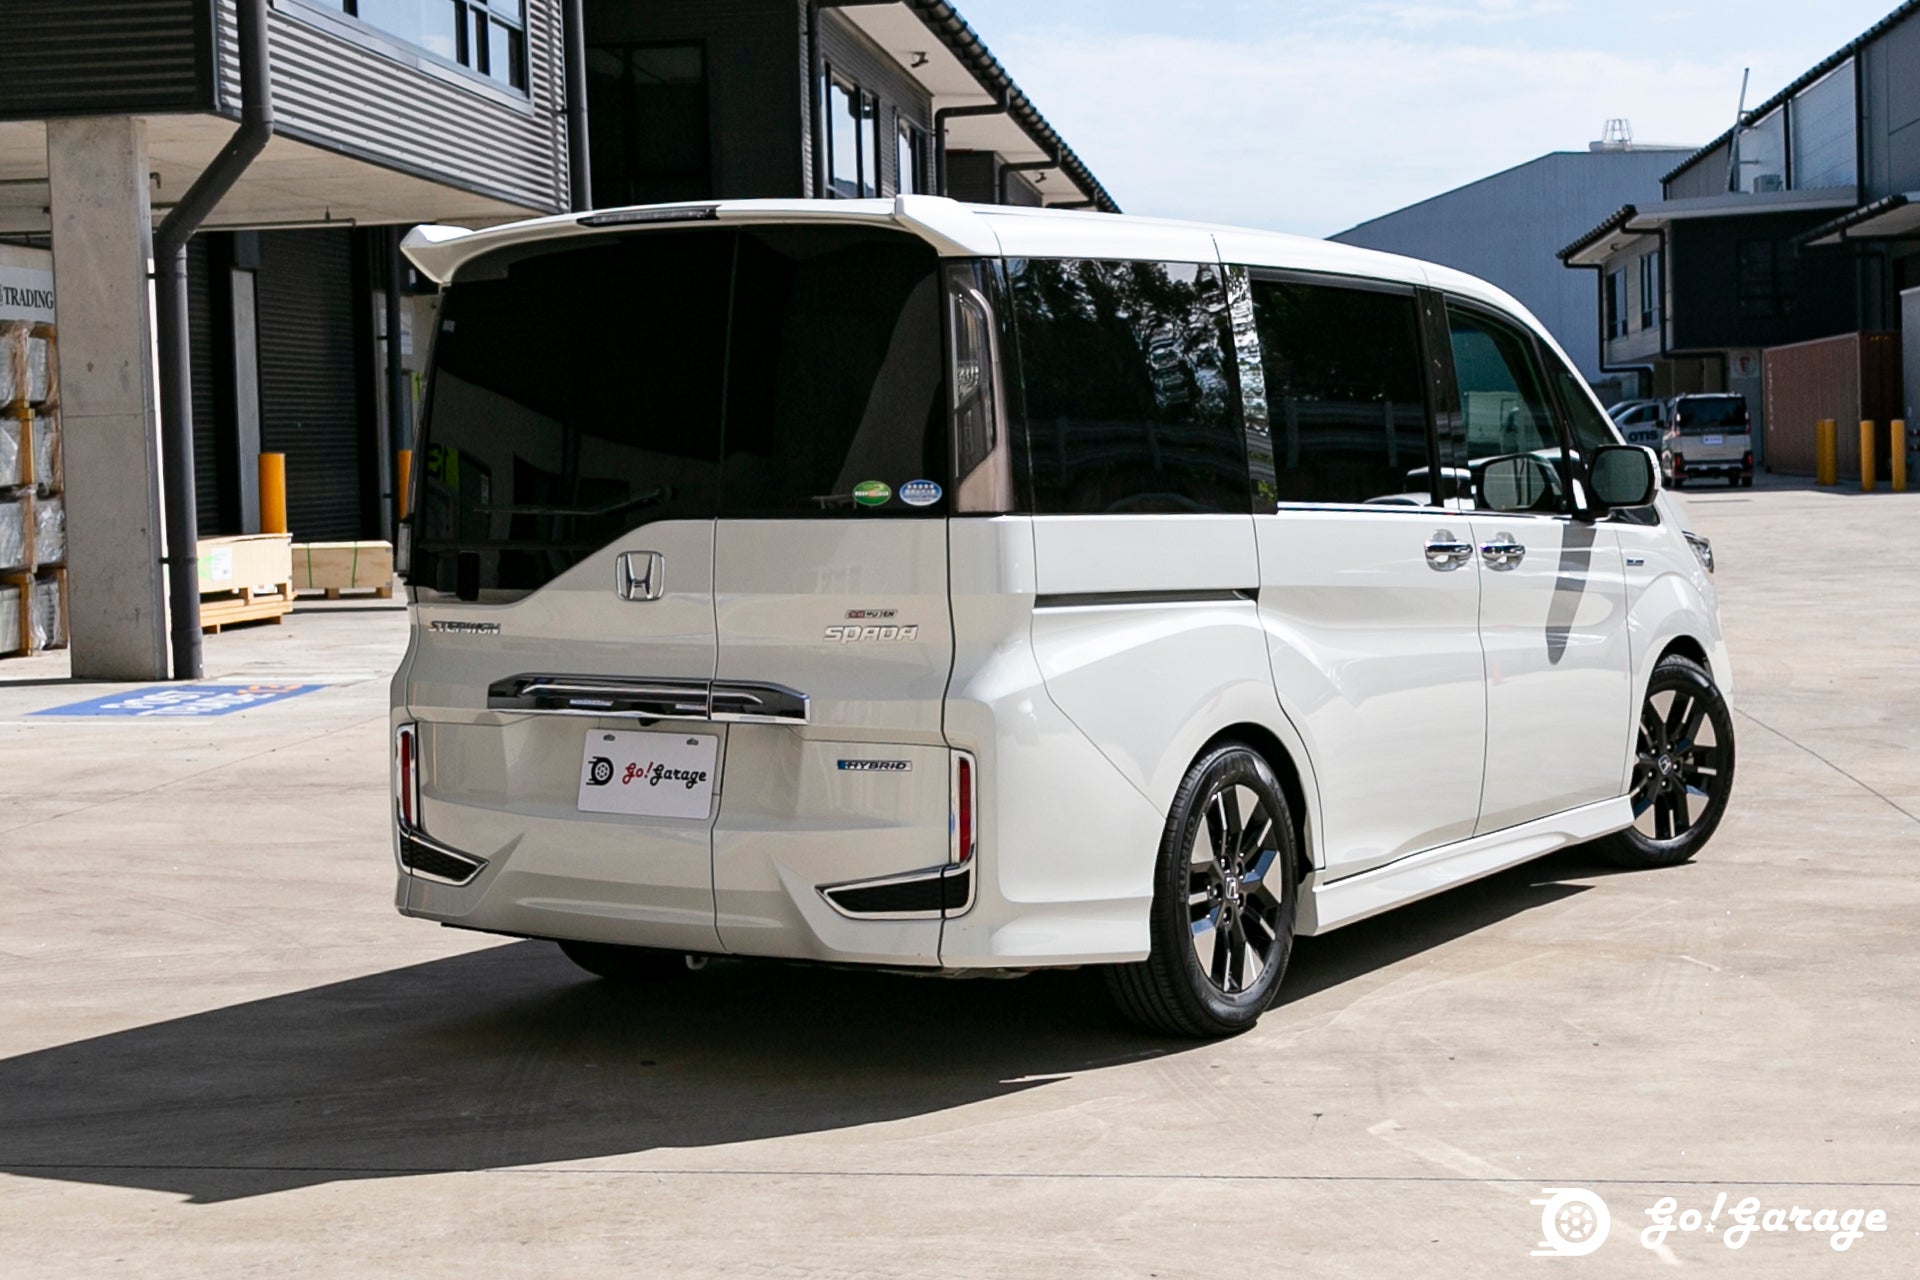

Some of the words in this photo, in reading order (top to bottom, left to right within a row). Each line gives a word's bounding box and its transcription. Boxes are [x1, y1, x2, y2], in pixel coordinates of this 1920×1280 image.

[4, 286, 54, 309] TRADING
[823, 625, 918, 644] SPADA
[847, 761, 907, 770] HYBRID
[650, 764, 707, 789] Garage
